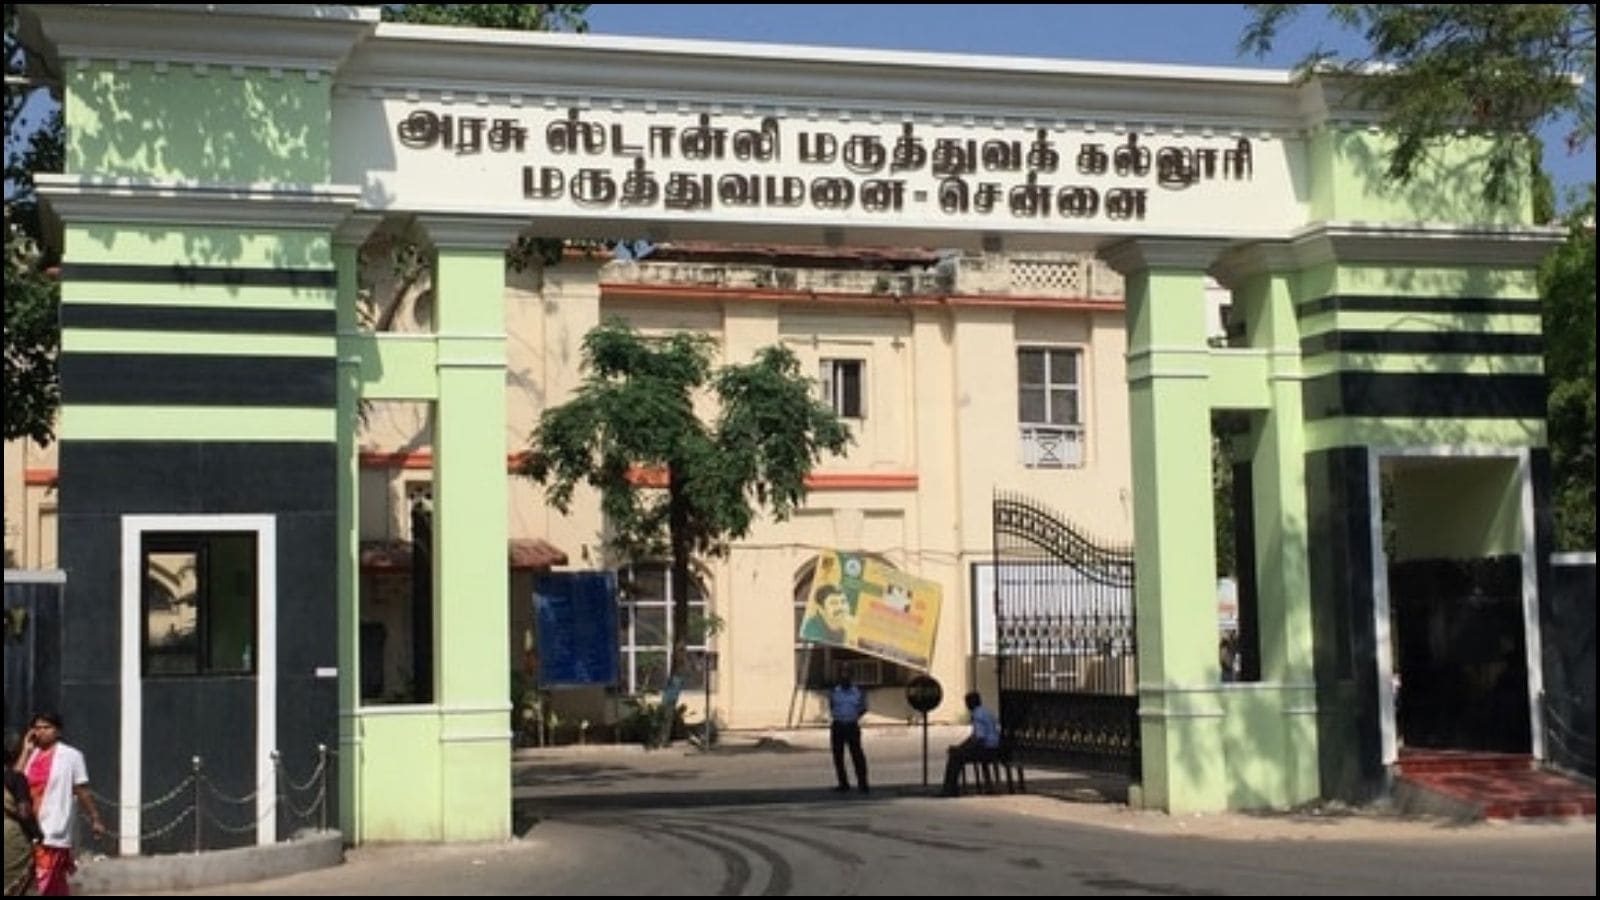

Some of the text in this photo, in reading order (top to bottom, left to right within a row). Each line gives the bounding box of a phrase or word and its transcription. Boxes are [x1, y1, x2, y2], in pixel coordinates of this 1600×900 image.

[398, 107, 1253, 189] அரசு ஸ்டான்லி மருத்துவக் கல்லூரி
